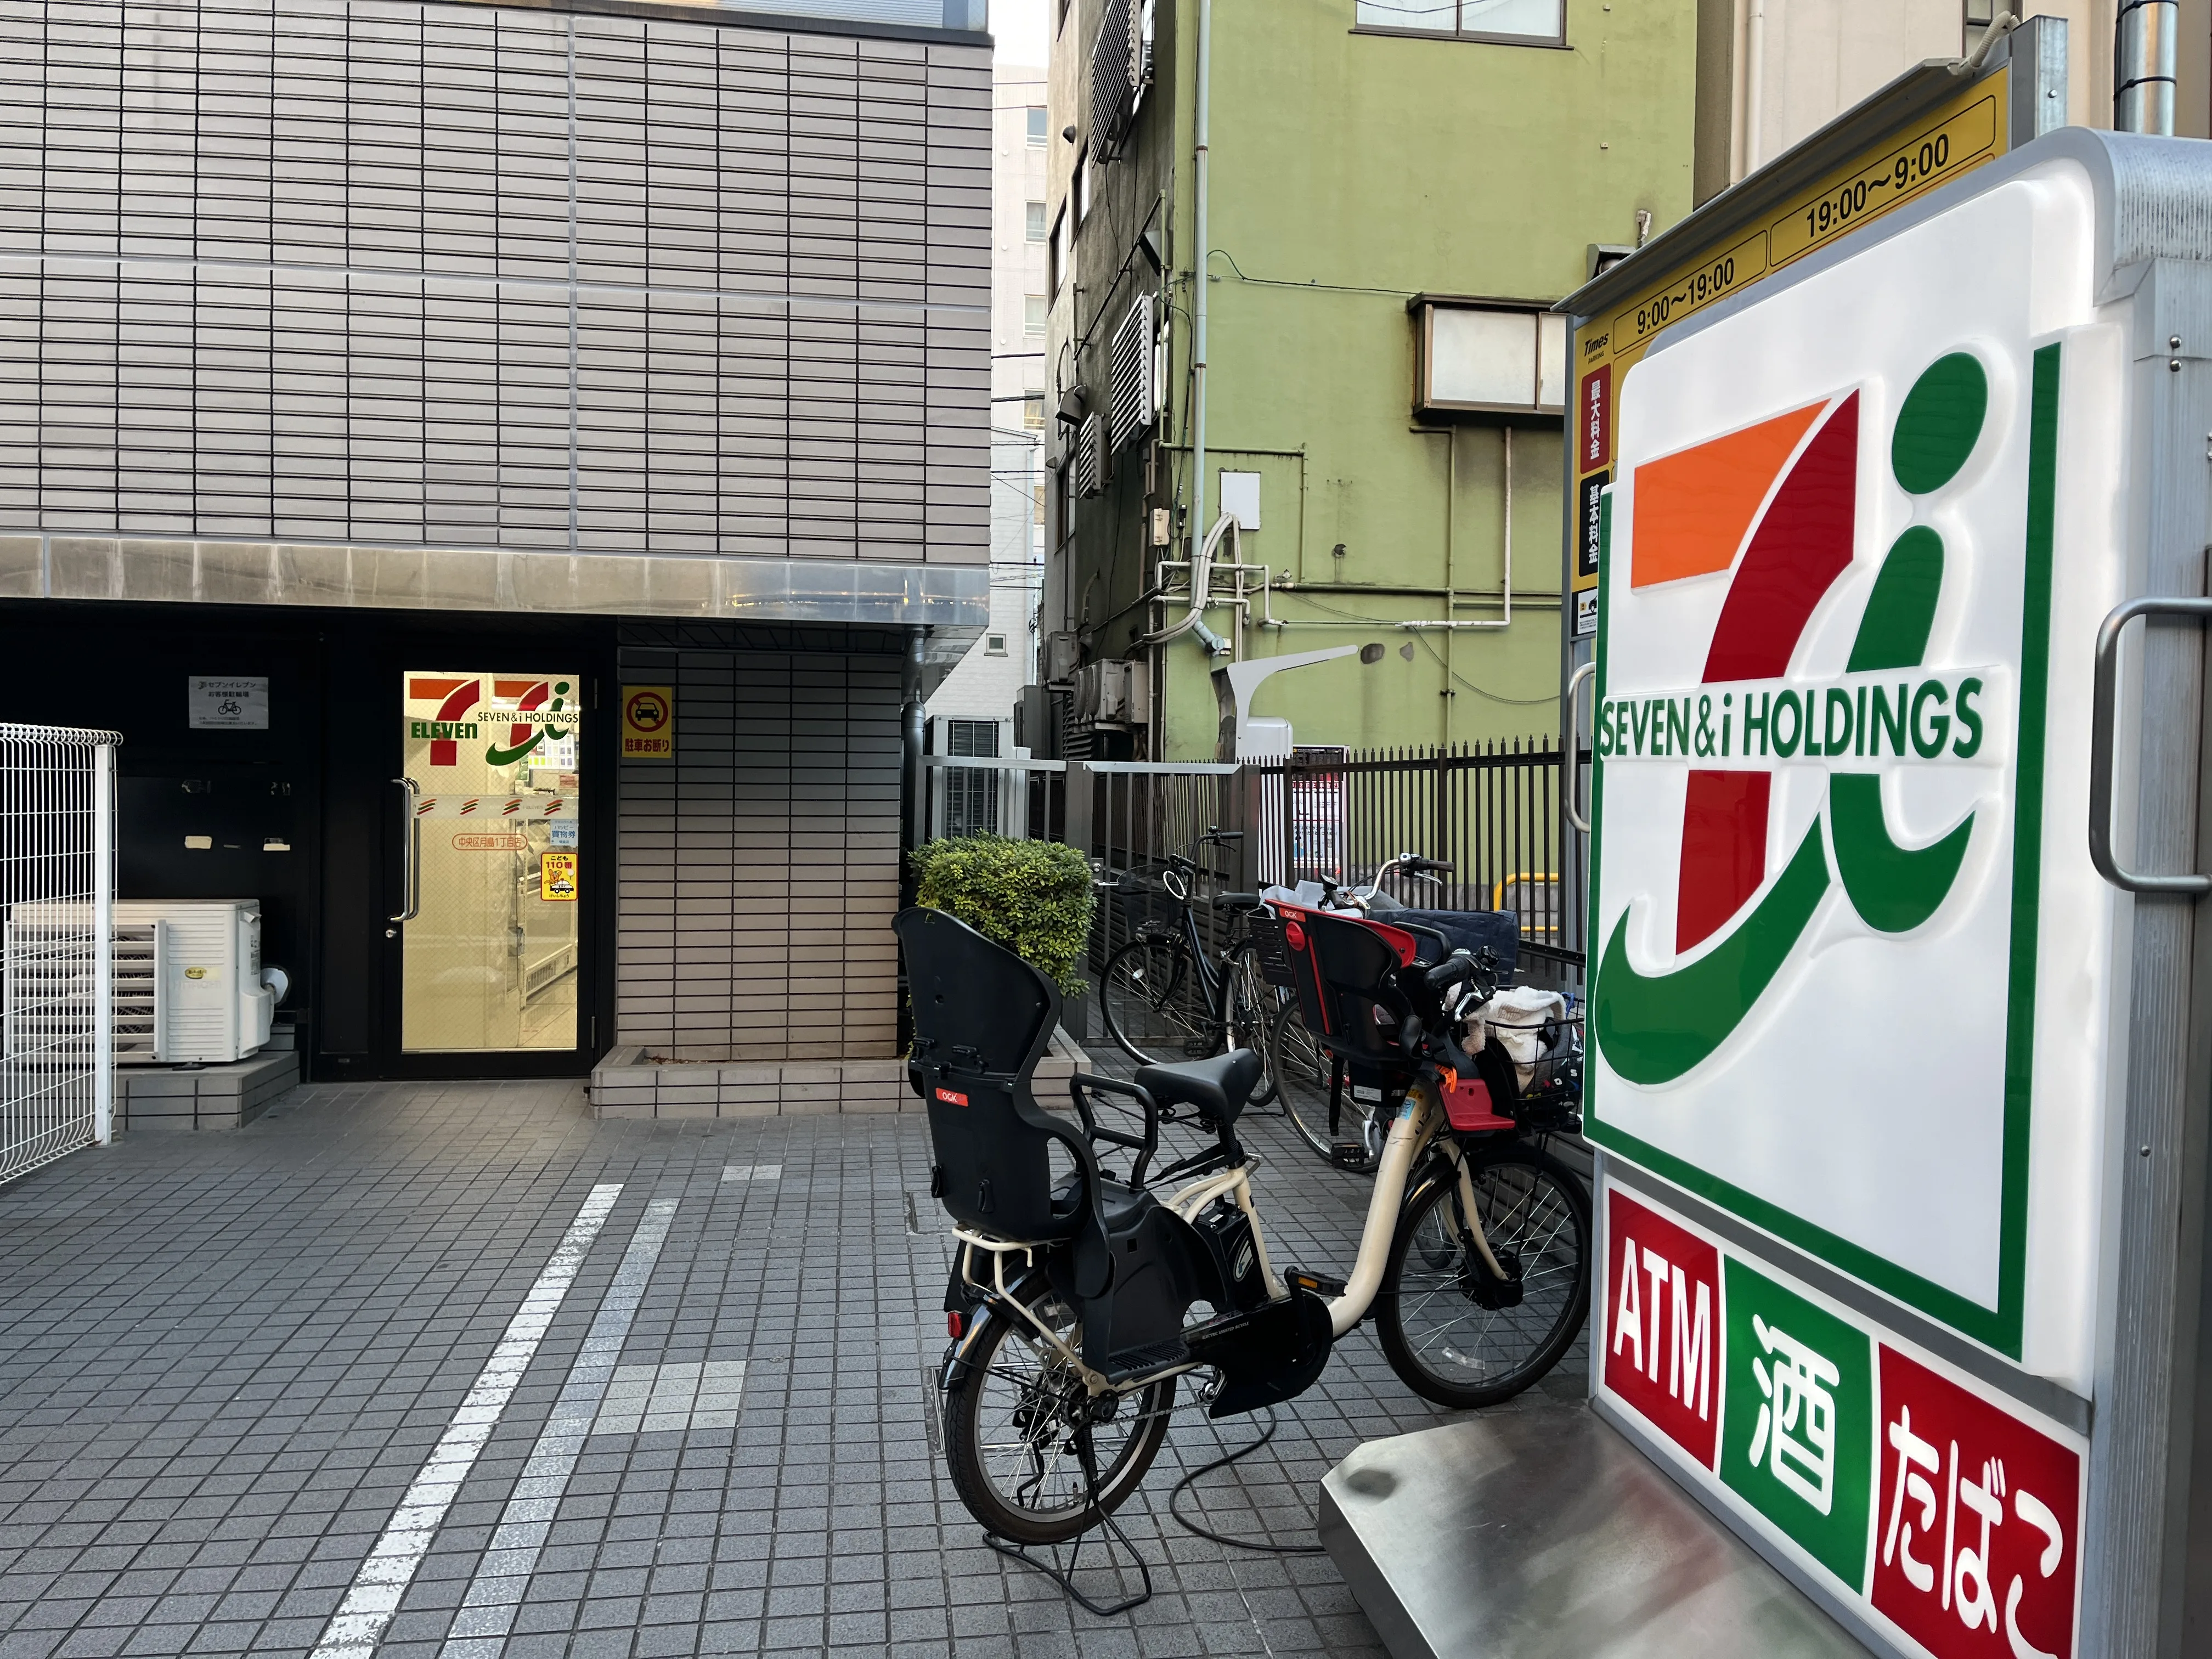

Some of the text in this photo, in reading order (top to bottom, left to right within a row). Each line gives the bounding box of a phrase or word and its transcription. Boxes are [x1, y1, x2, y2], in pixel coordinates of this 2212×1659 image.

[1584, 333, 1609, 357] Times
[1590, 379, 1601, 460] 最大料金
[1589, 484, 1599, 564] 基本料金
[525, 713, 578, 723] HOLDINGS
[625, 738, 669, 752] 駐車お断り
[1743, 677, 1984, 759] HOLDINGS
[459, 837, 521, 847] 中央区月島1丁目店
[943, 1092, 957, 1103] OGK
[1613, 1236, 1711, 1422] ATM
[1749, 1313, 1839, 1516] 酒
[1883, 1404, 2063, 1659] たばこ
